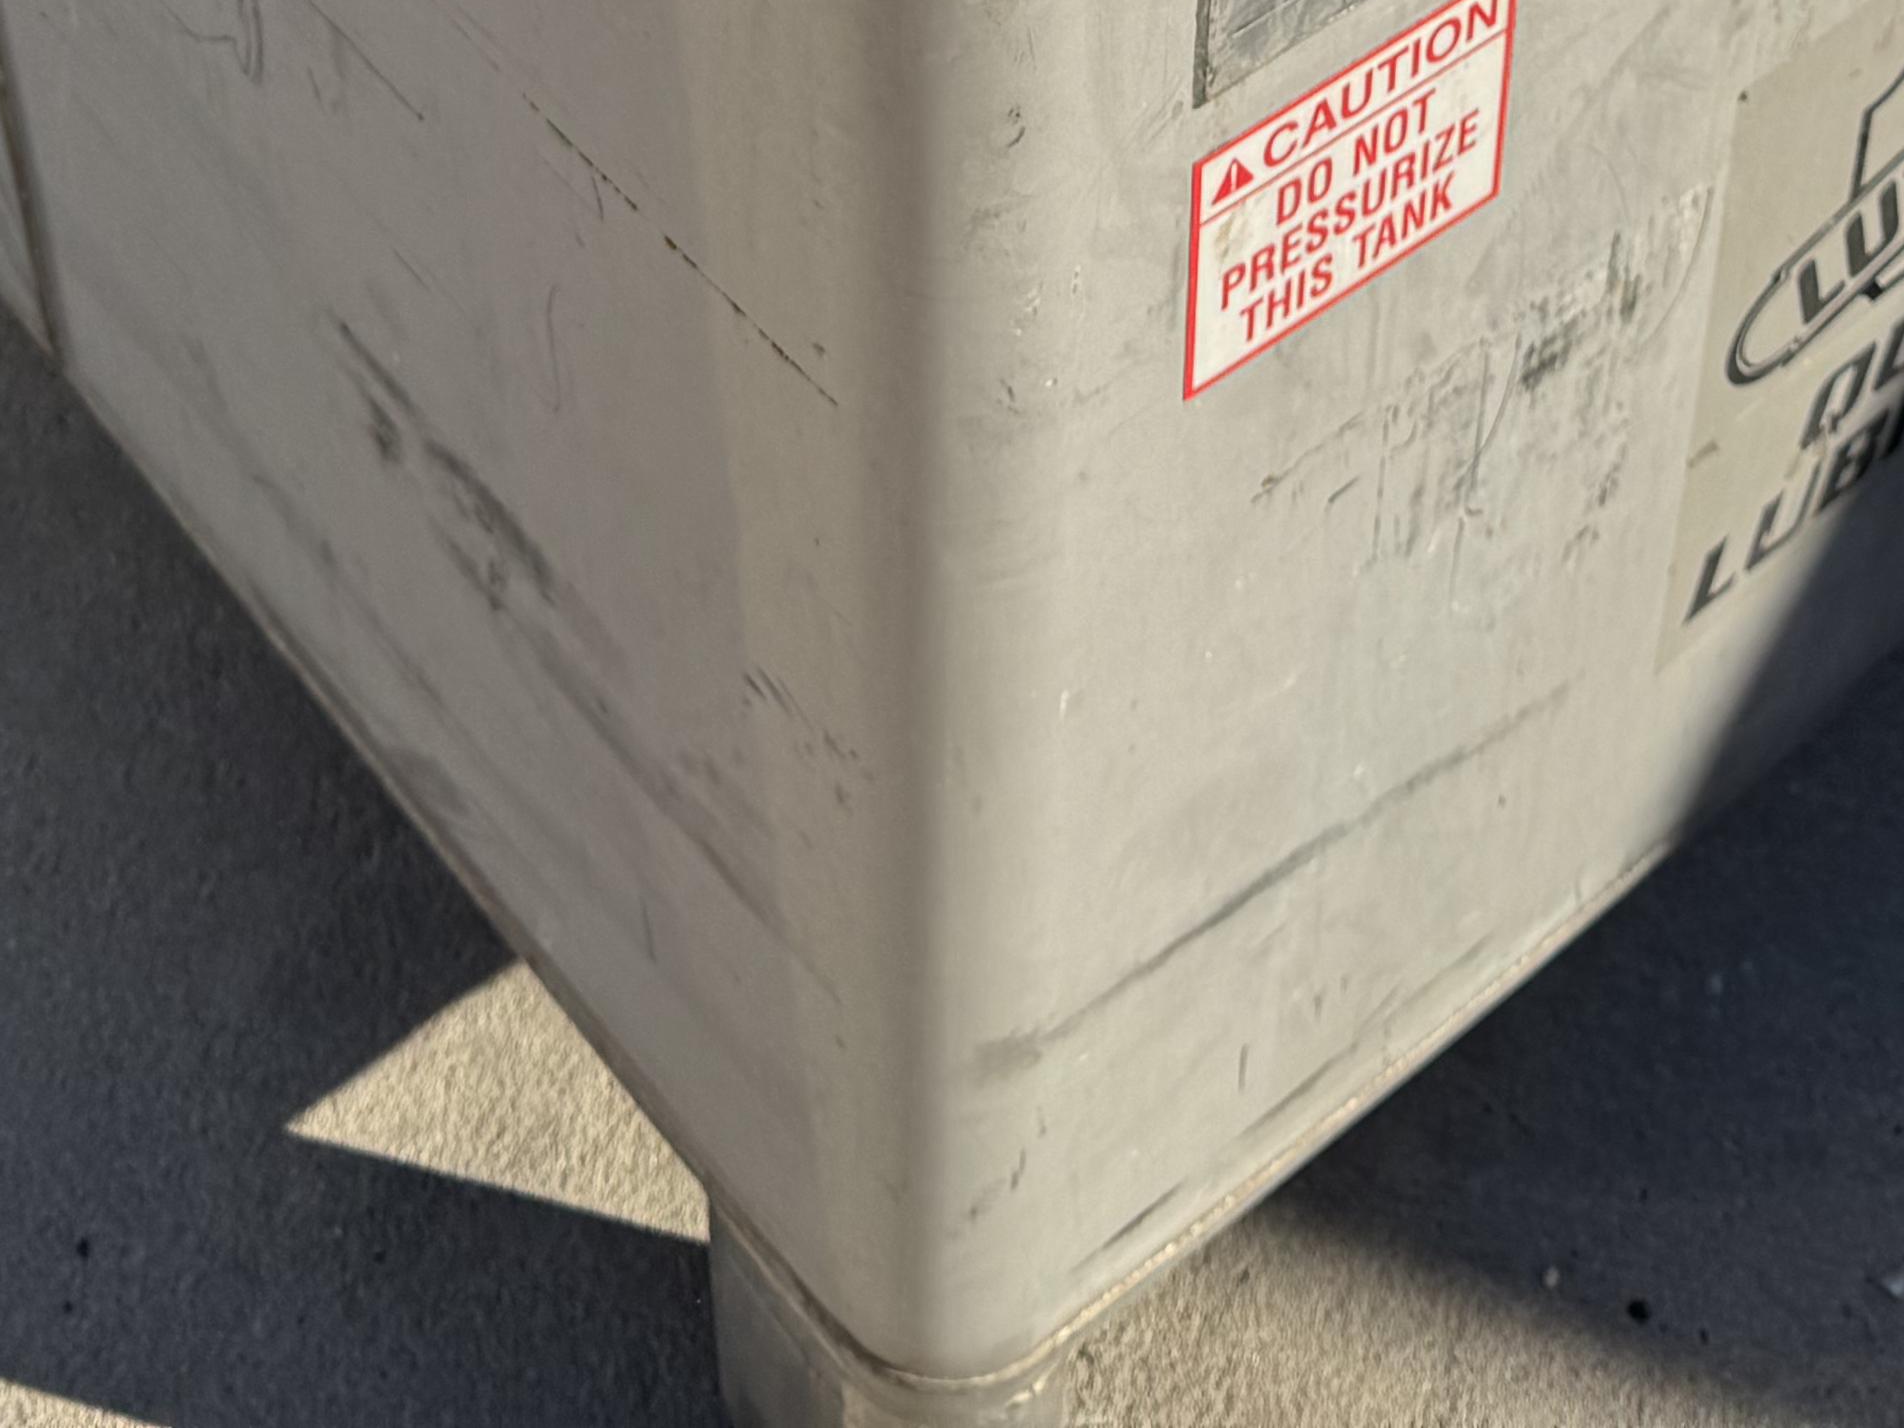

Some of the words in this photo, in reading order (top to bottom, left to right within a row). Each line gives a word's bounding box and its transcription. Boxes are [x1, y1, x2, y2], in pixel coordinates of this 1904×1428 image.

[1220, 108, 1480, 311] PRESSURIZE
[1275, 156, 1334, 228] DO
[1352, 88, 1436, 176] NOT
[1239, 253, 1334, 343] THIS
[1352, 171, 1457, 271] TANK
